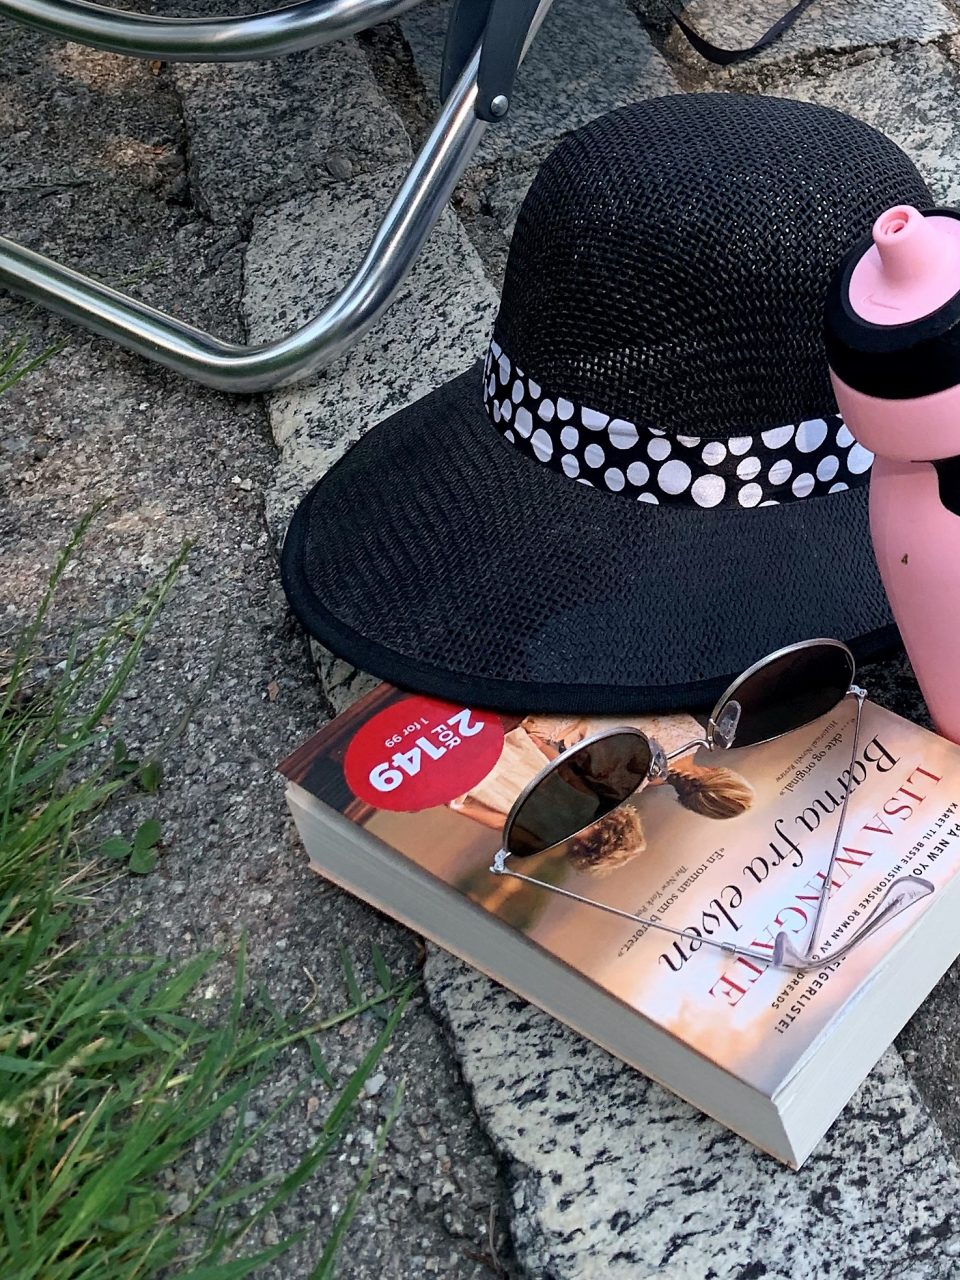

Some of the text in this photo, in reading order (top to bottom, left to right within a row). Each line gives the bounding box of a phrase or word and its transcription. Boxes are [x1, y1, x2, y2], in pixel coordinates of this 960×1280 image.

[403, 722, 421, 736] for
[385, 734, 402, 747] 99
[825, 733, 842, 750] ekte
[369, 708, 485, 792] 2 FOR 149
[812, 751, 827, 762] og
[659, 734, 900, 971] Barna fra elven
[706, 848, 725, 864] «En
[927, 839, 950, 862] NEW
[675, 865, 688, 877] The
[677, 864, 708, 893] roman
[661, 876, 677, 891] New
[708, 766, 943, 1007] LISA WINGATE
[646, 891, 663, 906] York
[657, 893, 678, 913] som
[771, 802, 958, 1009] KÅRET TIL BESTE HISTORISKE ROMAN AV GDREADS
